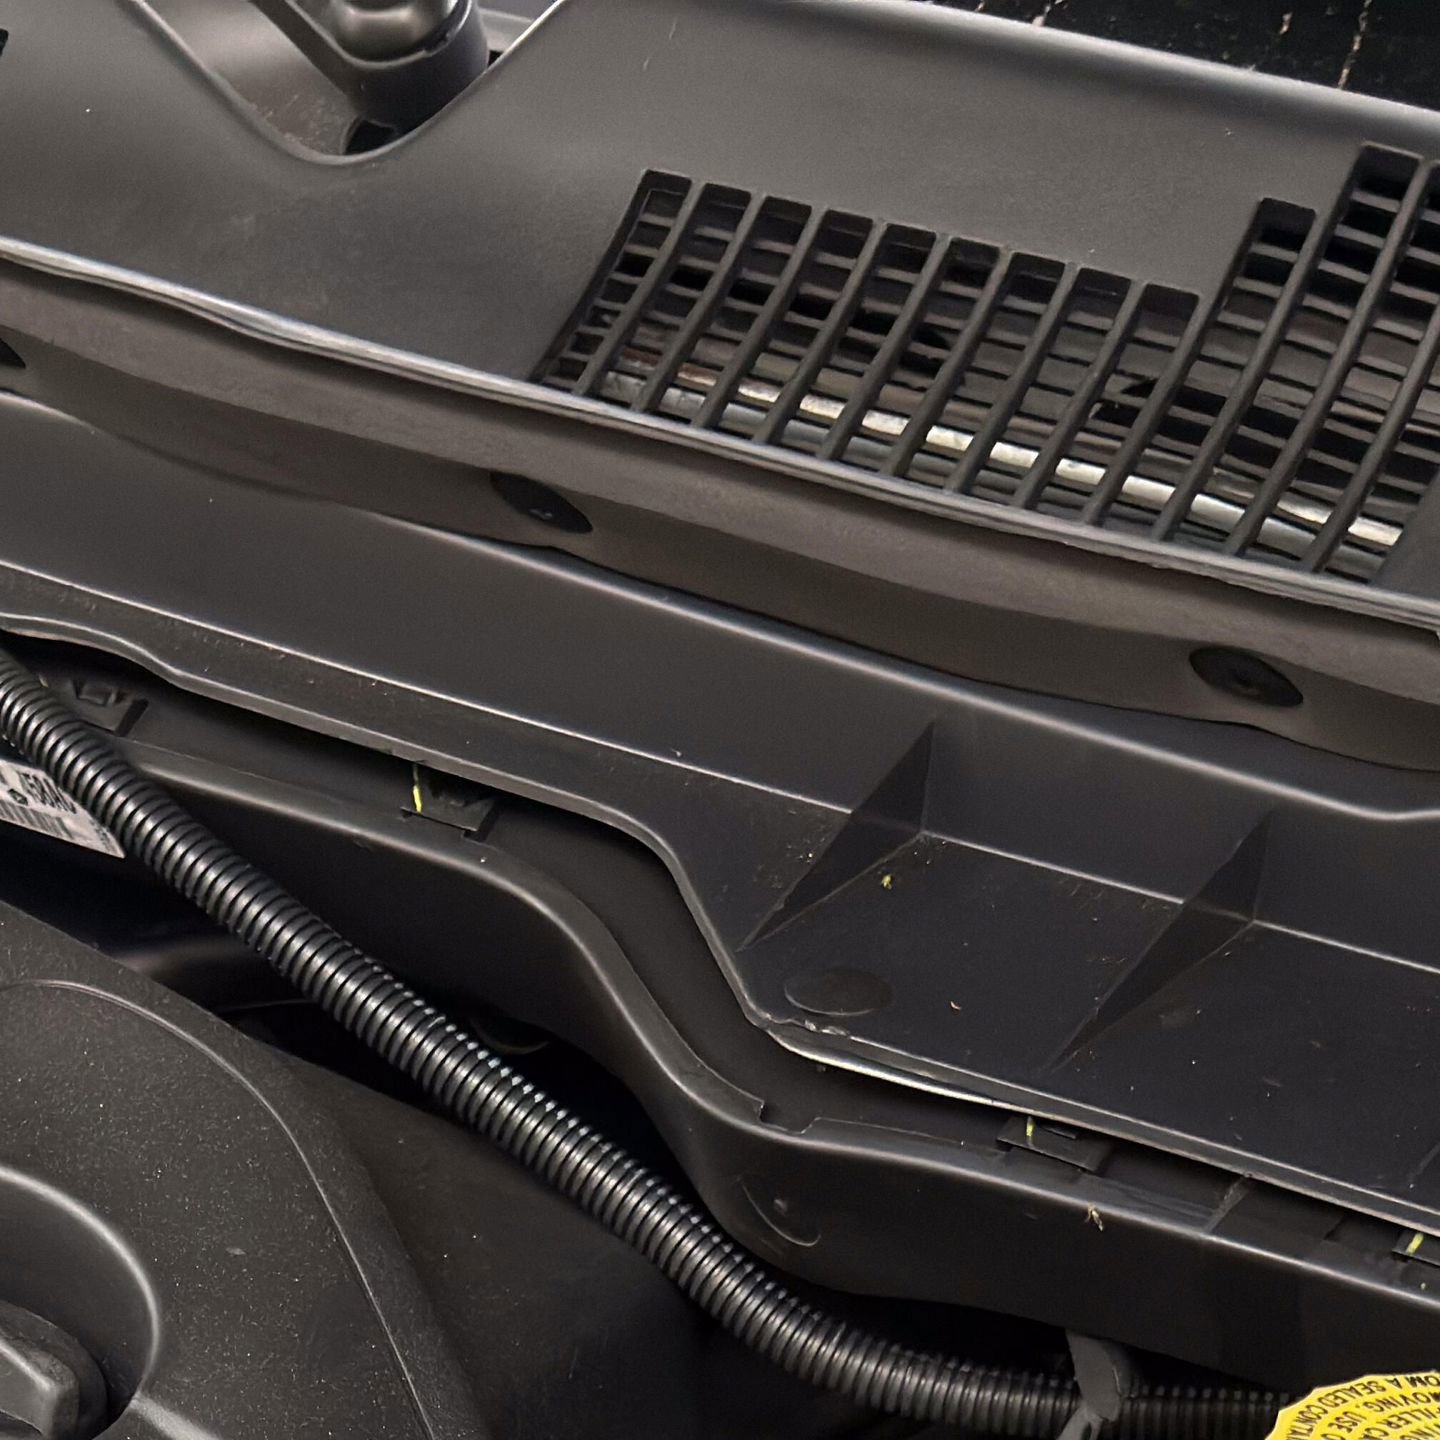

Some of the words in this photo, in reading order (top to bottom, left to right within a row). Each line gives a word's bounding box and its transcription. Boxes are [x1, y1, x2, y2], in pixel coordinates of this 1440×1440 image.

[1317, 1380, 1386, 1408] SEALED
[1385, 1377, 1402, 1389] A
[1328, 1410, 1367, 1434] USE
